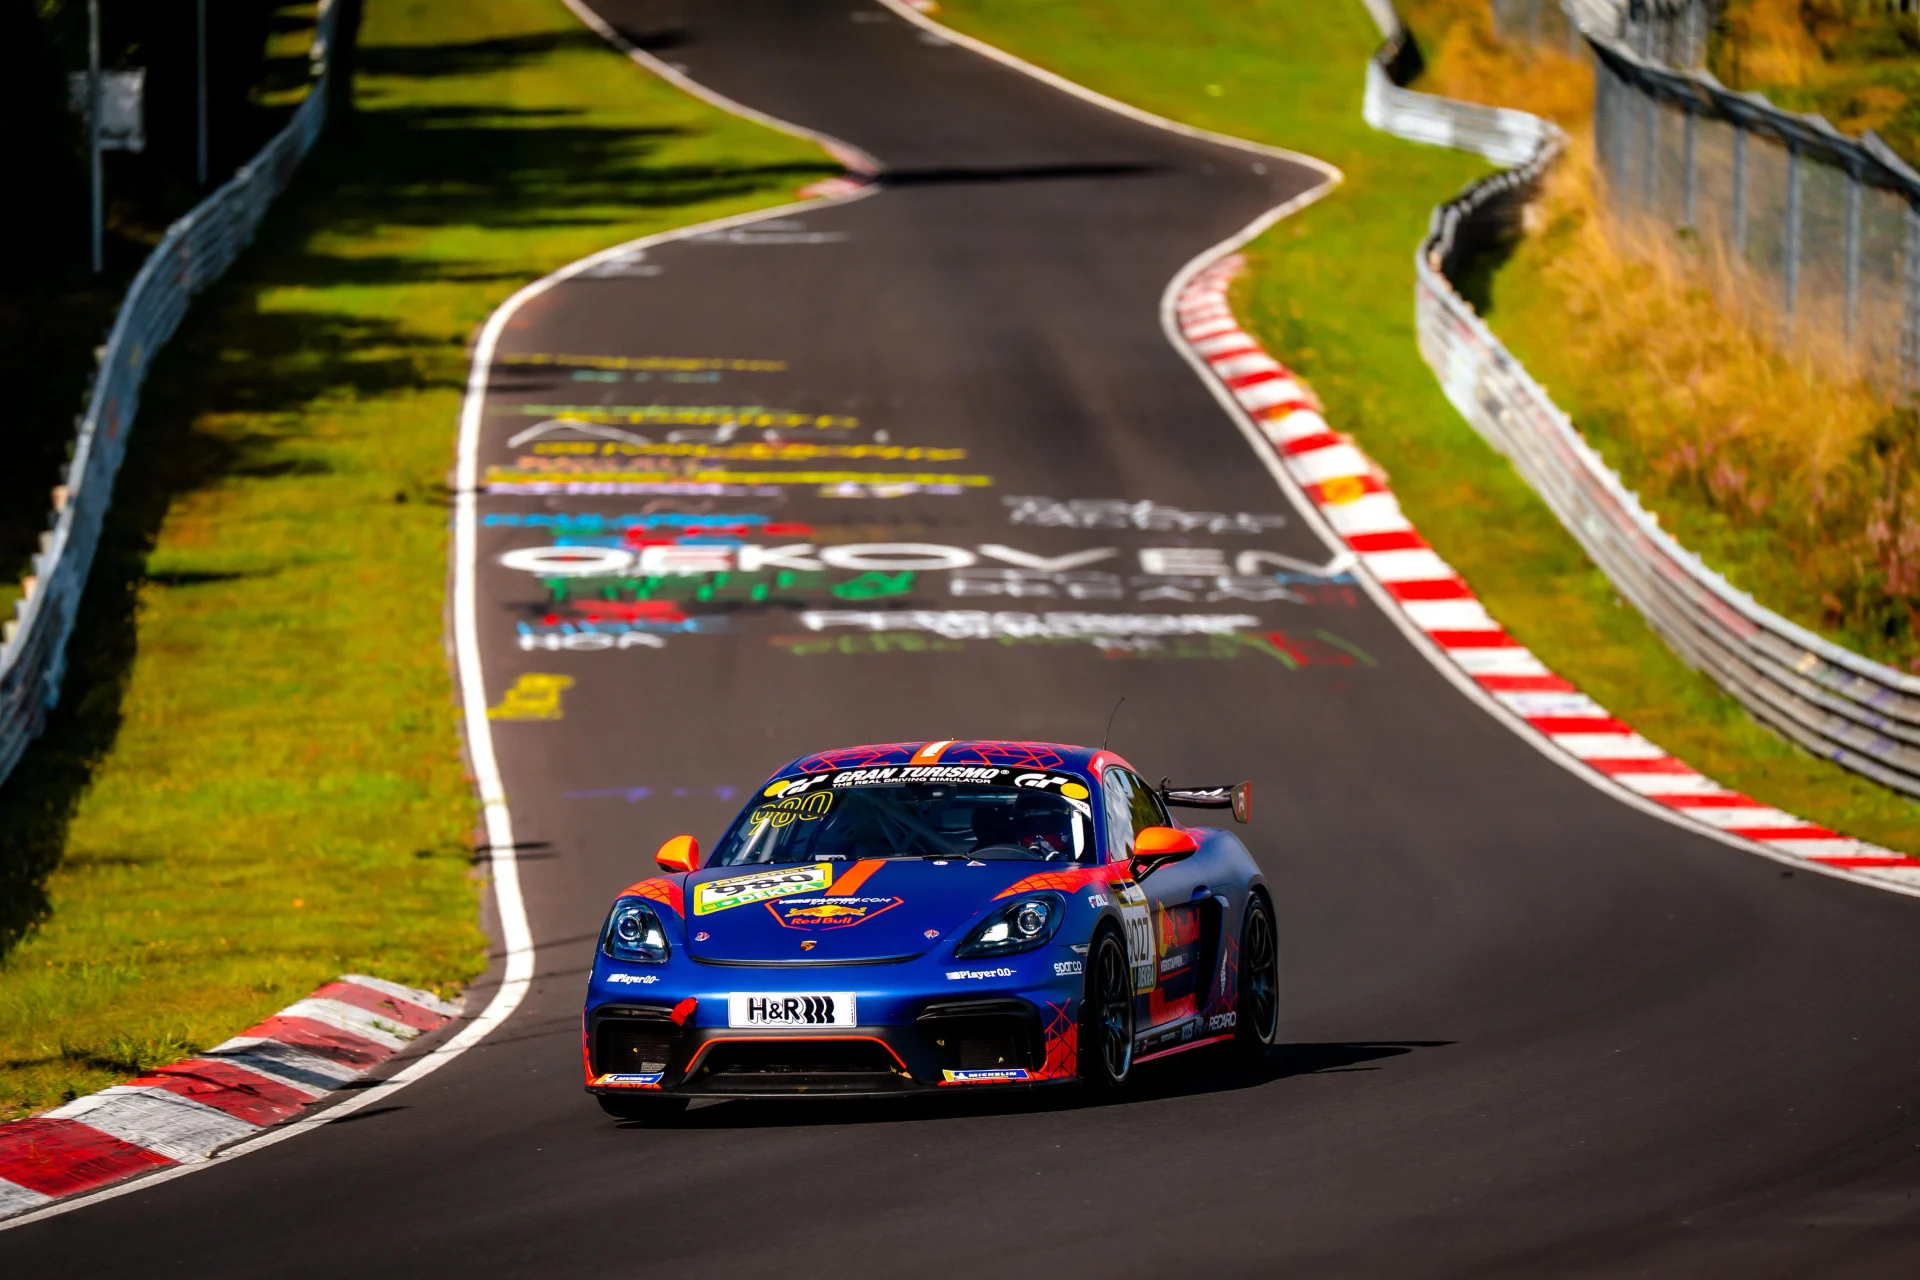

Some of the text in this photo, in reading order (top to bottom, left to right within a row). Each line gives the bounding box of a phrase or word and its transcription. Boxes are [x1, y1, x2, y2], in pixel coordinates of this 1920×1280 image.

[833, 767, 895, 783] GRAN
[855, 778, 882, 786] REAL
[929, 776, 991, 784] SIMULATOR
[748, 791, 834, 836] 980
[713, 873, 814, 896] 980
[737, 883, 818, 903] DEKRA
[791, 916, 853, 925] Red Bull
[959, 969, 997, 980] Player
[1053, 960, 1082, 976] sparco
[747, 995, 804, 1023] H&R
[1208, 1010, 1237, 1031] RECARO
